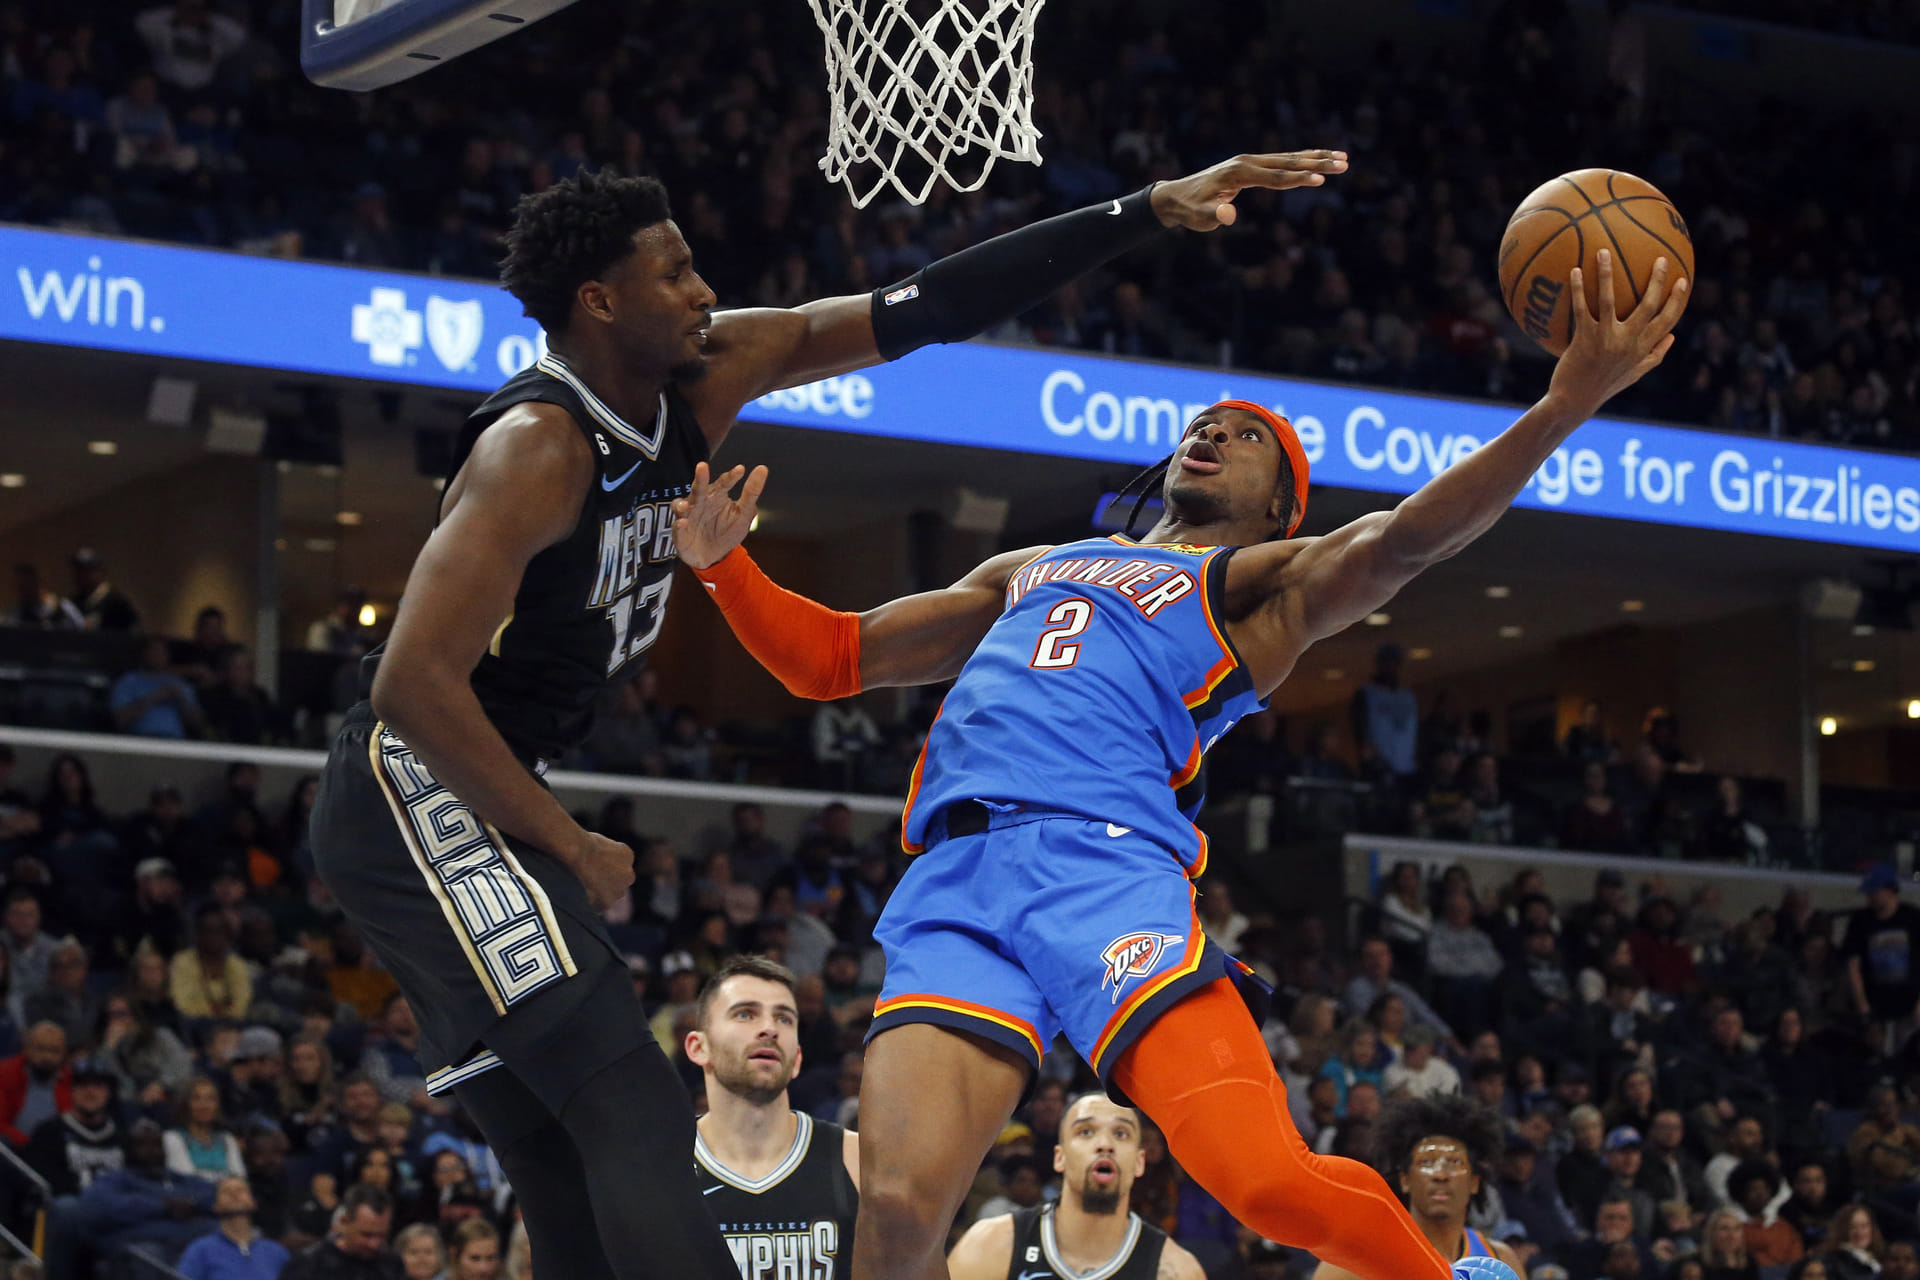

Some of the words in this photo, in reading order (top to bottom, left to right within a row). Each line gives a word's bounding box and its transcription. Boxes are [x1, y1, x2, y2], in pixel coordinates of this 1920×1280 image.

[17, 256, 166, 333] win.
[595, 433, 610, 455] 6
[1344, 405, 1604, 506] Covege
[1619, 439, 1695, 506] for
[1710, 450, 1920, 533] Grizzlies
[1008, 558, 1197, 620] THUNDER
[606, 572, 673, 679] 13
[1029, 597, 1094, 669] 2
[1112, 937, 1151, 986] OKC
[1025, 1246, 1040, 1263] 6
